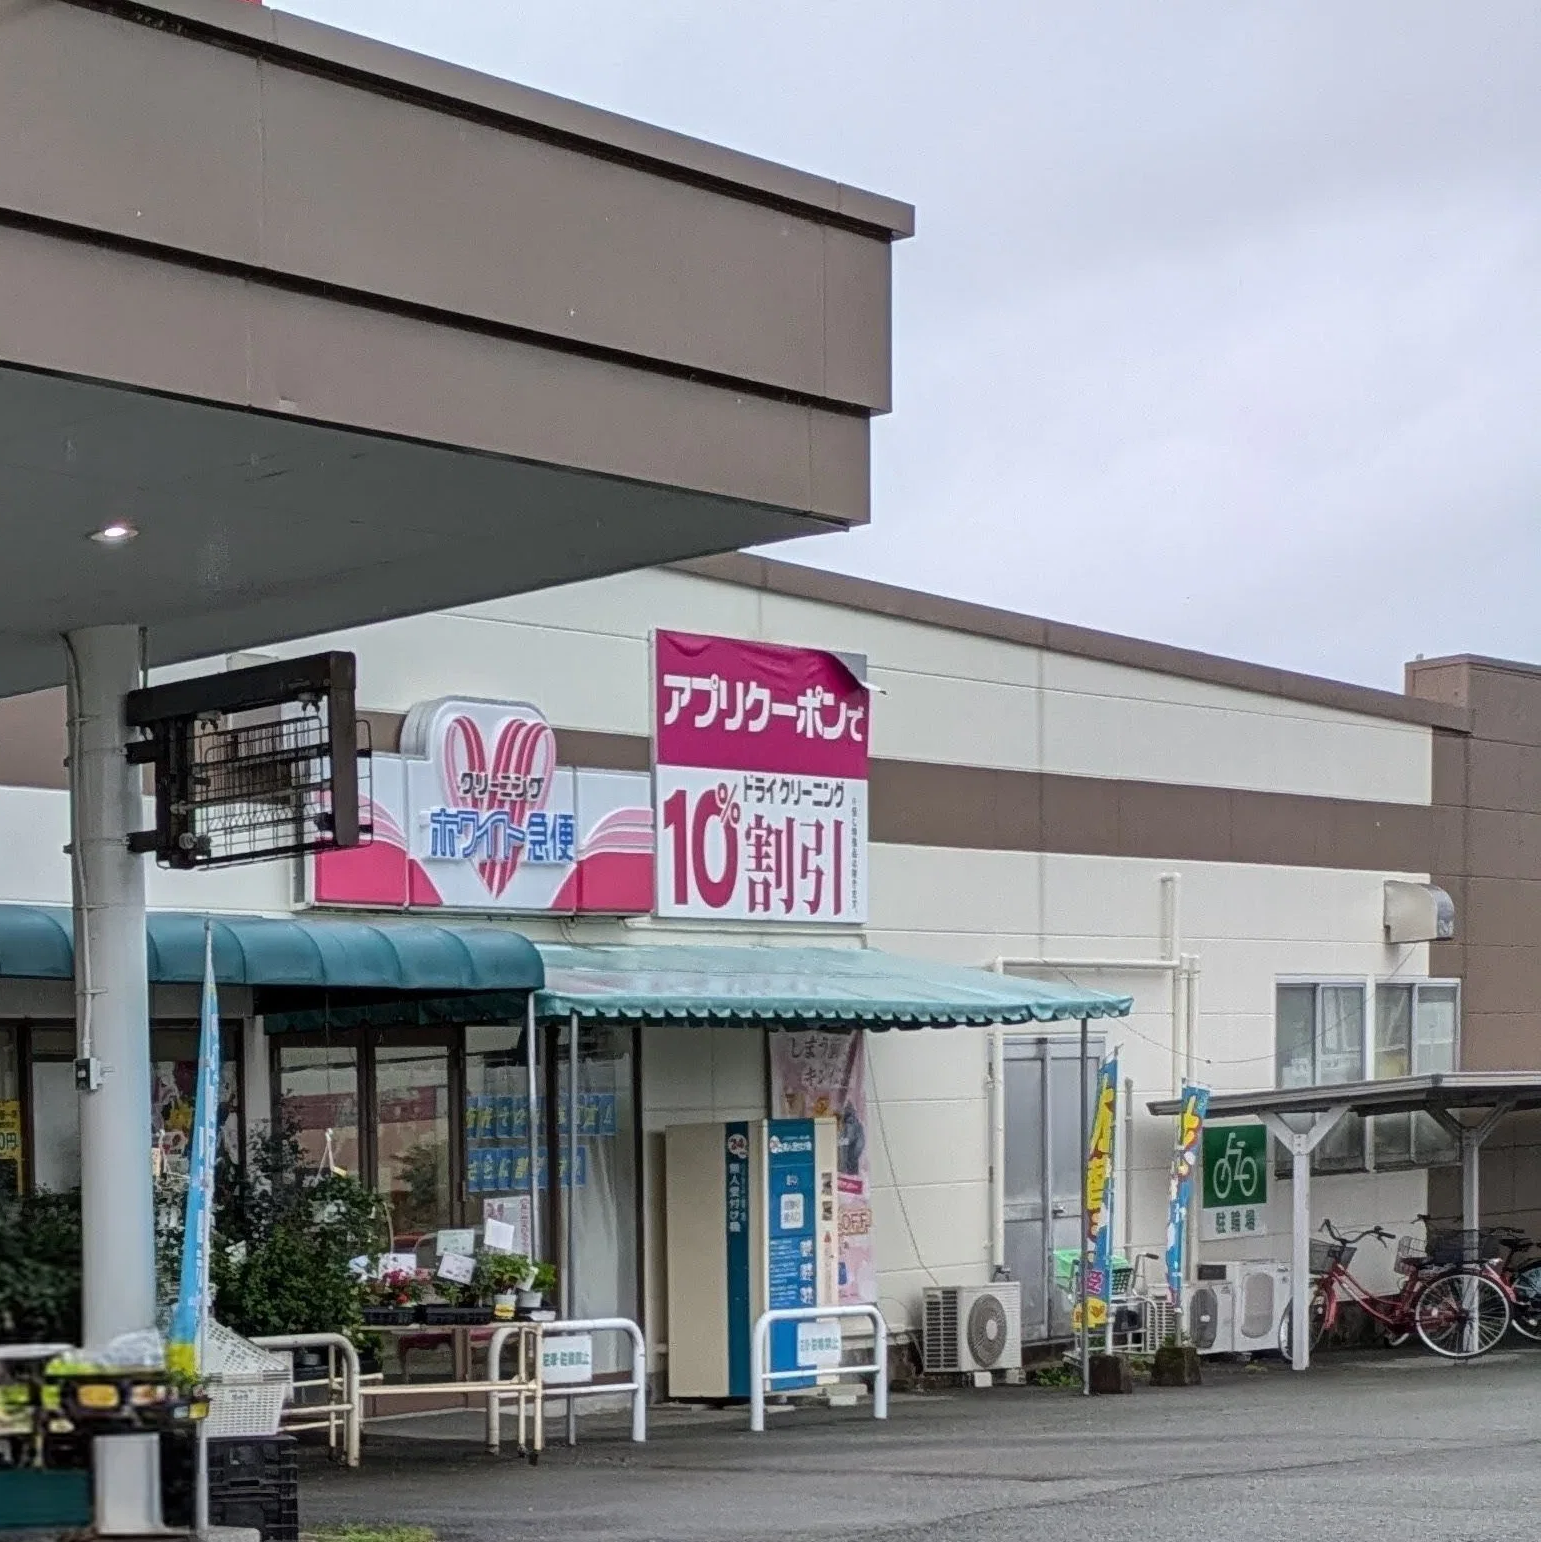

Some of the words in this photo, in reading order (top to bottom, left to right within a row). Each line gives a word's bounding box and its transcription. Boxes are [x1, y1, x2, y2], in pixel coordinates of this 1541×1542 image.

[664, 673, 864, 741] アプリクーポンで
[460, 772, 545, 799] クリーニング
[744, 775, 845, 808] ドライクリーニング
[430, 808, 574, 861] ホワイト急便
